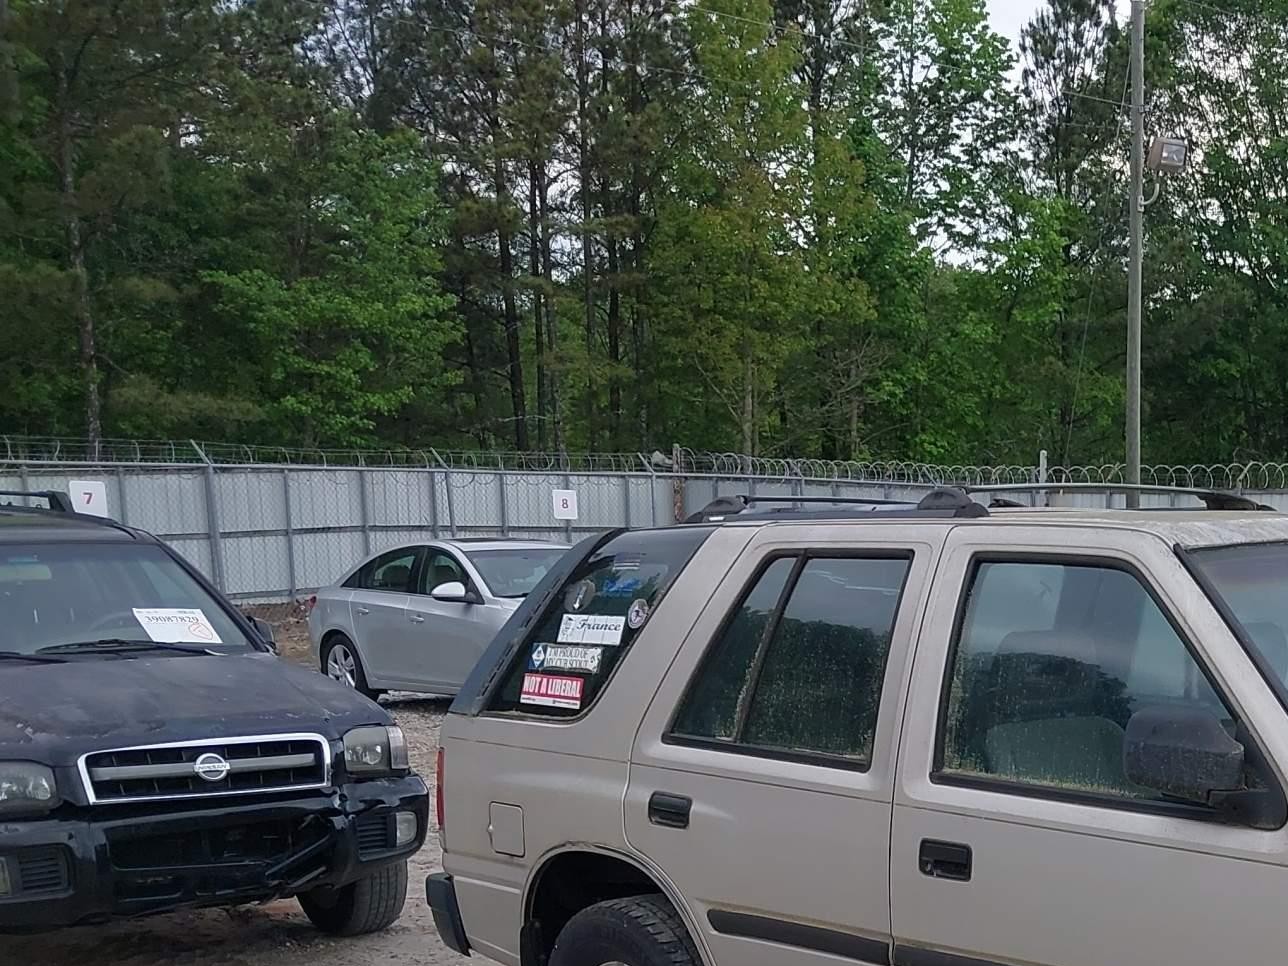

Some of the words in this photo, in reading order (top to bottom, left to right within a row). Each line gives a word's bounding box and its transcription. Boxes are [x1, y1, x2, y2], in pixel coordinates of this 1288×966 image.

[82, 492, 93, 504] 7
[561, 498, 569, 509] 8
[576, 619, 622, 632] France
[523, 675, 542, 693] NOT
[539, 677, 548, 694] A
[547, 678, 581, 698] LIBERAL
